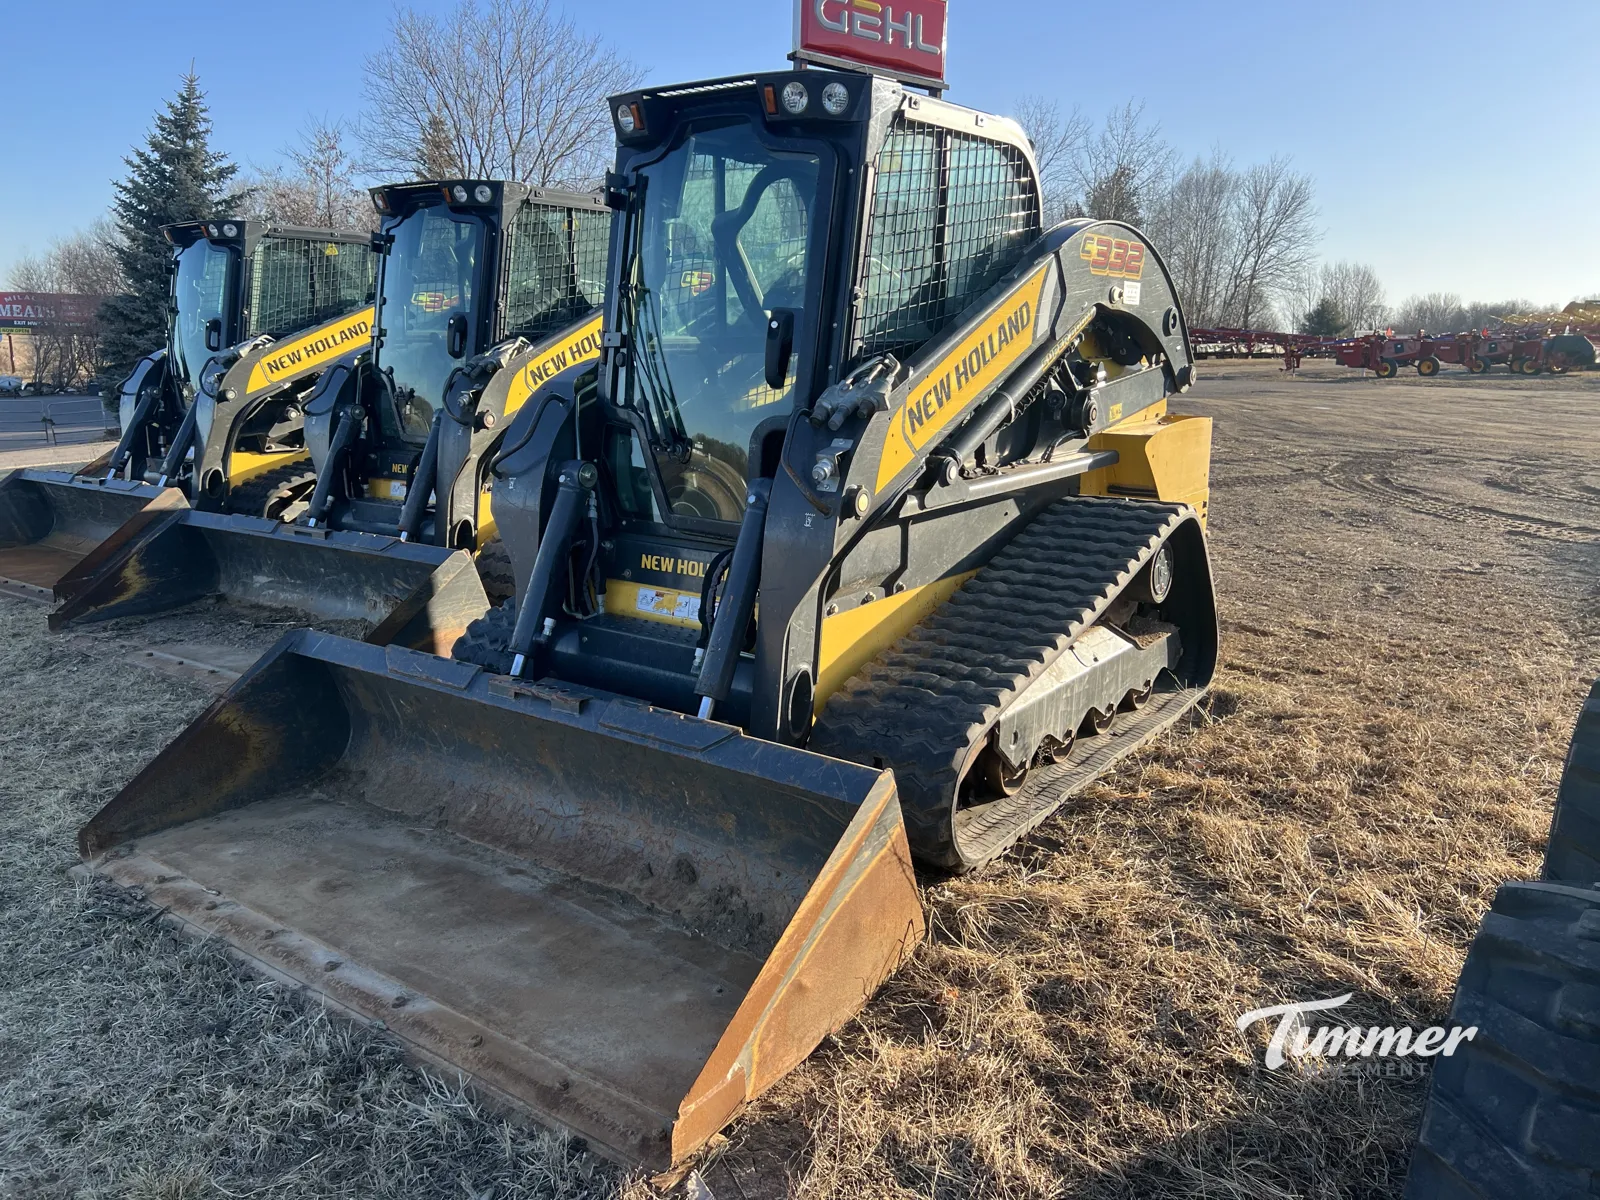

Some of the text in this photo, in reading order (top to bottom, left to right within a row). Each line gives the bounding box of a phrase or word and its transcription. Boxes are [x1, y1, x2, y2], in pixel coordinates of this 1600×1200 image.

[815, 0, 941, 55] GEHL
[0, 304, 56, 318] MEATS
[4, 294, 44, 303] MILAC
[266, 321, 369, 374] NEW HOLLAND
[529, 350, 567, 386] NEW
[907, 301, 1031, 436] NEW HOLLAND
[391, 463, 409, 474] NEW
[641, 553, 674, 573] NEW
